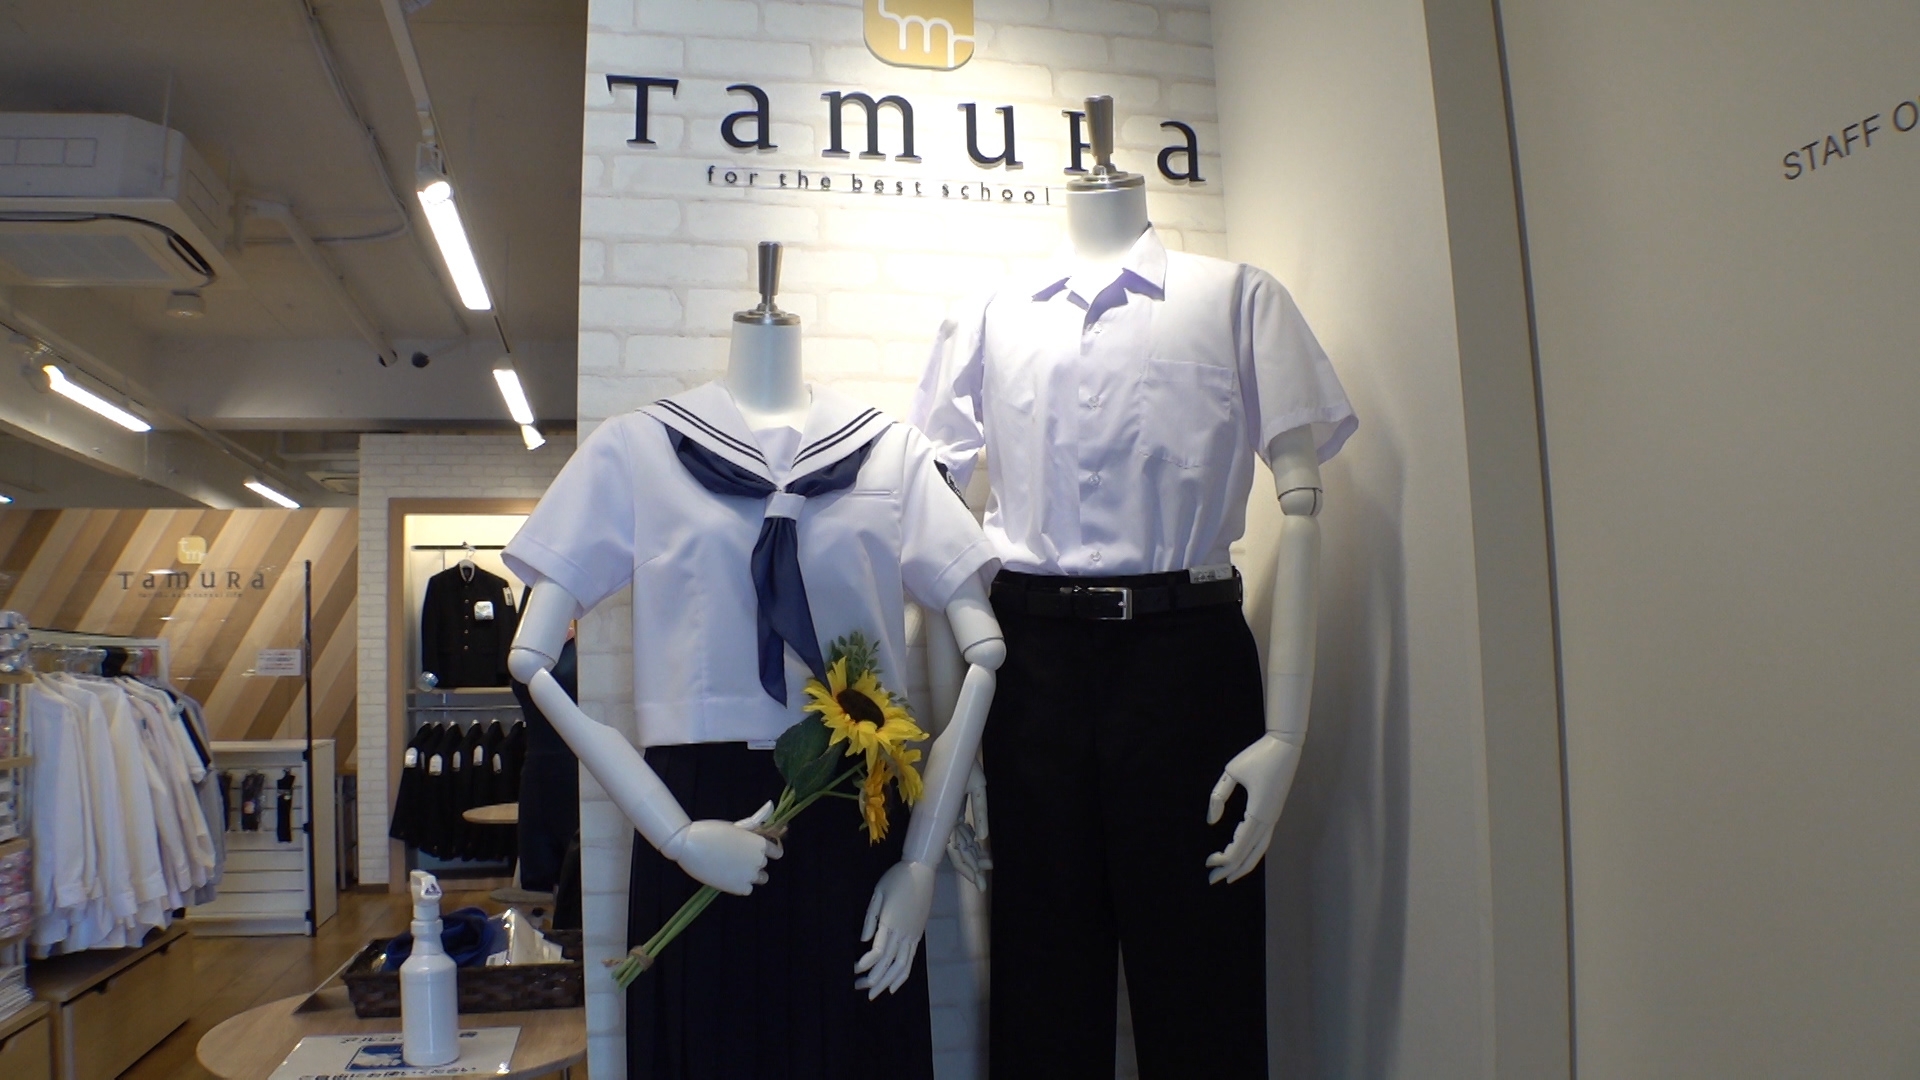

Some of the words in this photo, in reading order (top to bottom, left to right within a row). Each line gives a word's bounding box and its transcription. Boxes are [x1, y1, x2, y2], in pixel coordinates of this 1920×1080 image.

[1783, 113, 1881, 180] STAFF
[707, 165, 758, 184] for
[778, 169, 832, 191] the
[851, 173, 923, 196] best
[941, 181, 1051, 205] school
